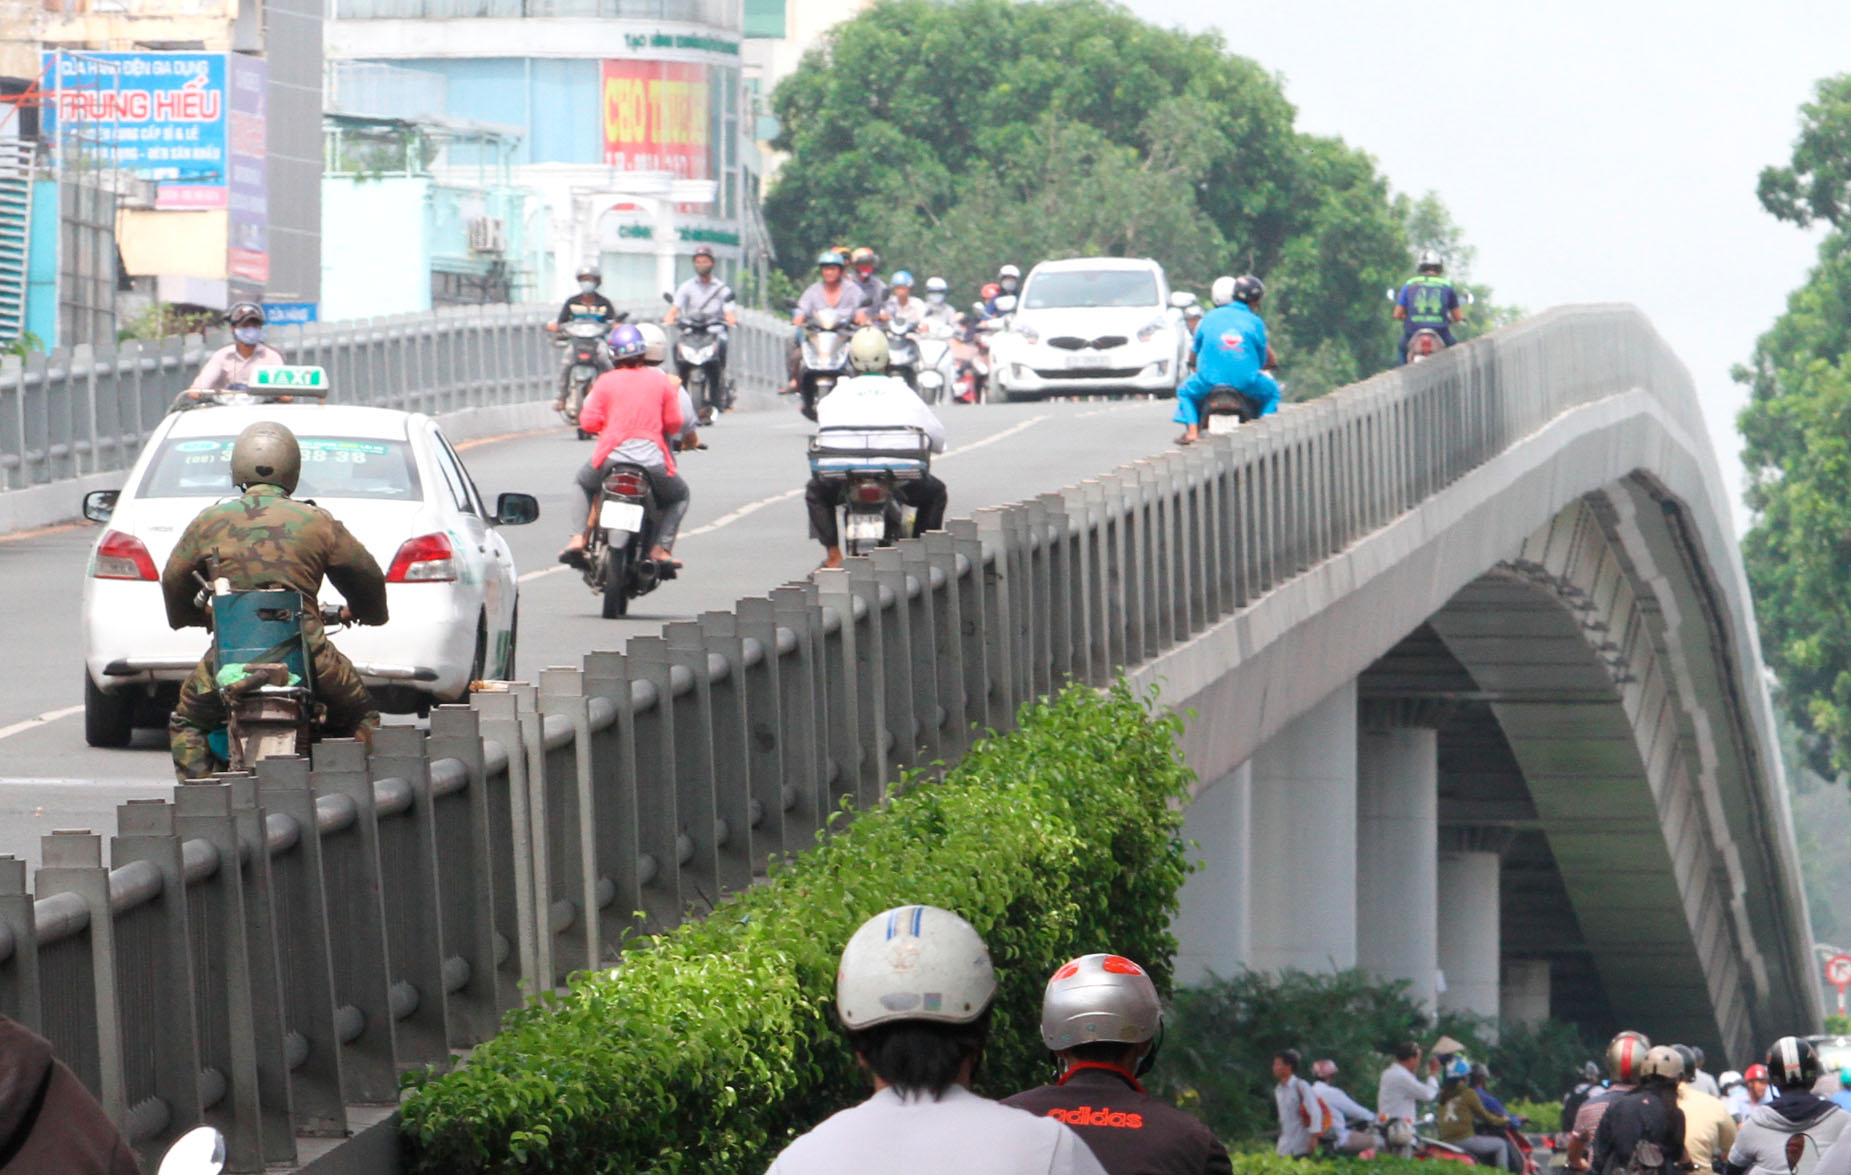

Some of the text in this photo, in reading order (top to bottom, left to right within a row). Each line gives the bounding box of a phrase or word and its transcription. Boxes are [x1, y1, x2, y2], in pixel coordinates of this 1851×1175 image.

[60, 92, 149, 119] TRUNG
[155, 76, 219, 119] HIẾU
[1047, 1106, 1144, 1129] adidas
